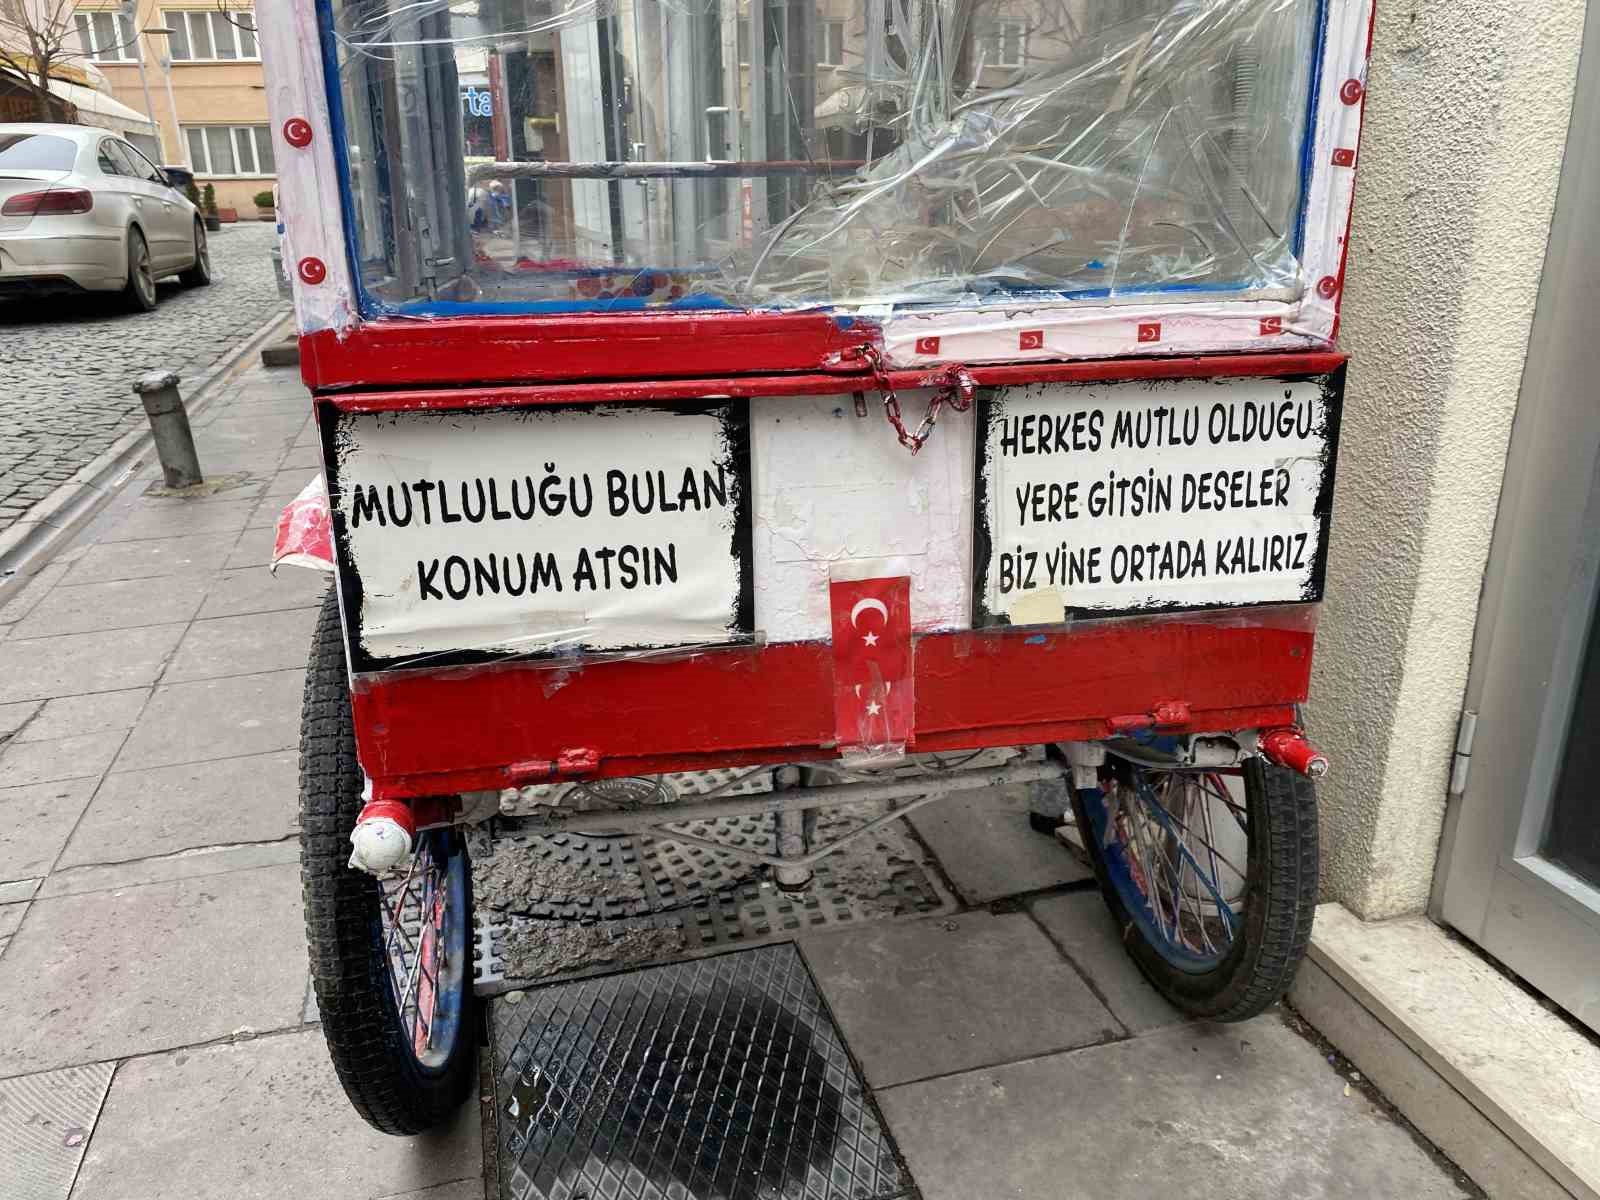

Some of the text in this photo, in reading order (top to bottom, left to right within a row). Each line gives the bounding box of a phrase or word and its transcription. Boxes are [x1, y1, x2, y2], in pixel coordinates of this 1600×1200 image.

[461, 86, 493, 117] ta
[1001, 389, 1313, 457] HERKES MUTLU OLDUĞU
[352, 463, 727, 528] MUTLULUĞU BULAN
[1016, 467, 1291, 526] YERE GİTSİN DESELER
[418, 543, 679, 601] KONUM ATSIN
[1000, 532, 1309, 594] BİZ YİNE ORTADA KALIRIZ
